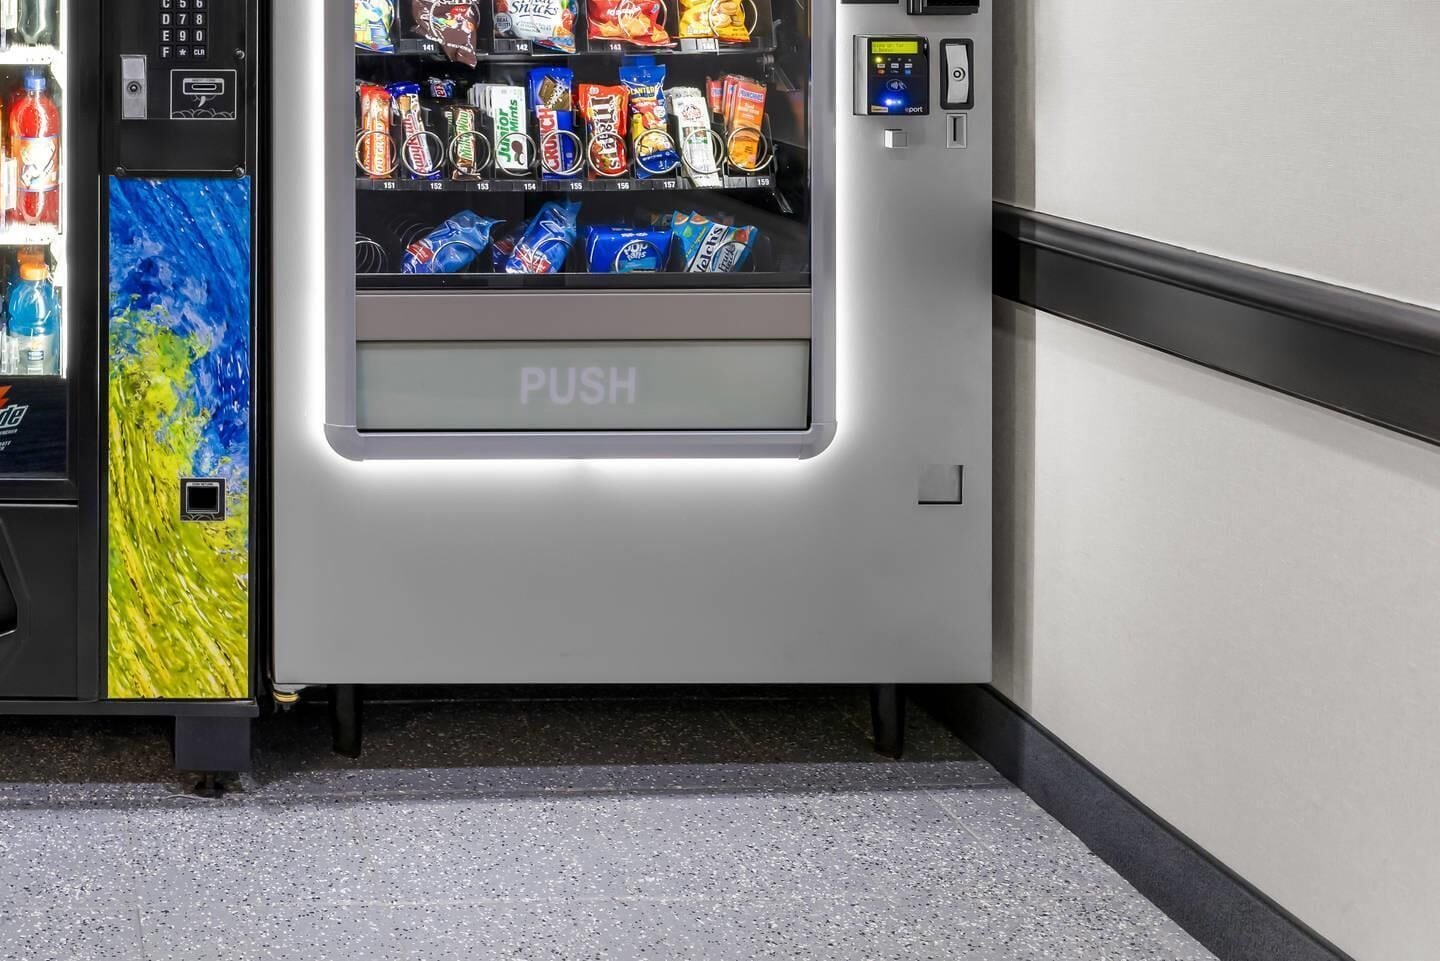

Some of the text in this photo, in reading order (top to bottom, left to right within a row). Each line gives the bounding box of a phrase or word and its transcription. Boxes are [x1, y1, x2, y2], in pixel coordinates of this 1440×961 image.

[162, 14, 203, 25] D 7 8
[162, 30, 203, 41] E 9 0
[162, 46, 206, 58] F CLR
[422, 43, 434, 51] 141
[516, 43, 528, 51] 142
[510, 98, 519, 132] Mints
[497, 108, 511, 162] Junior
[430, 182, 443, 190] 152
[617, 182, 629, 190] 156
[520, 366, 637, 405] PUSH
